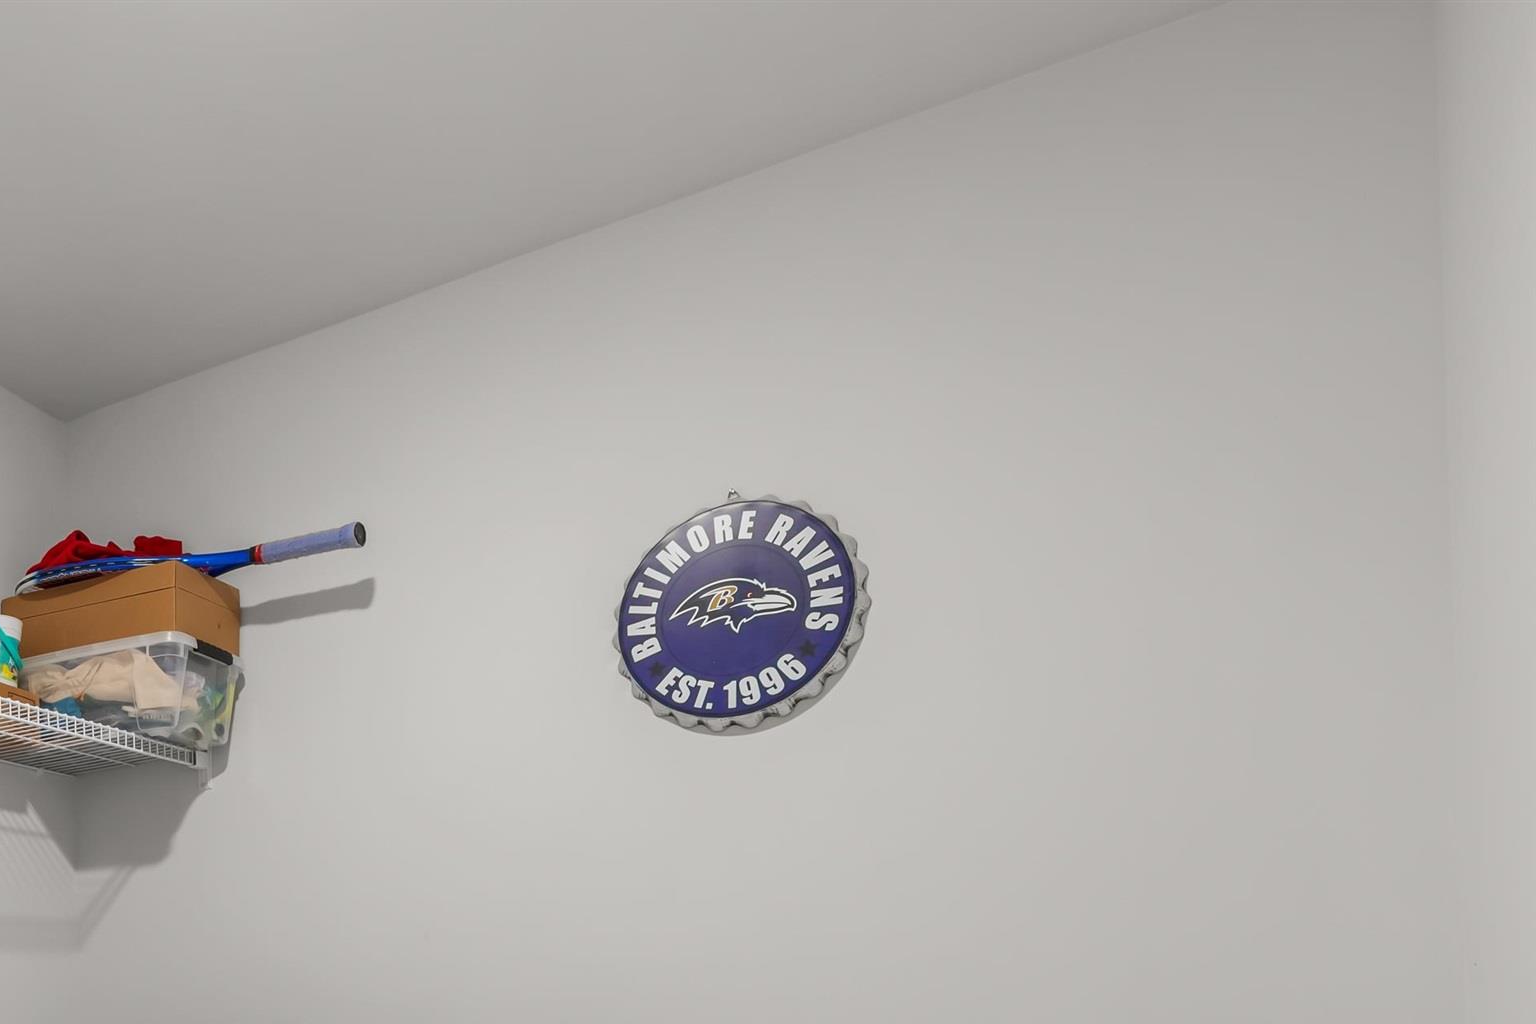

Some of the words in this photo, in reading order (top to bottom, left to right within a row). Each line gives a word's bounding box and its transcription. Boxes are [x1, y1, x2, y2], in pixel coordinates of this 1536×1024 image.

[627, 510, 757, 663] BALTIMORE
[765, 514, 843, 631] RAVENS
[656, 667, 715, 709] EST.
[723, 653, 807, 708] 1996
